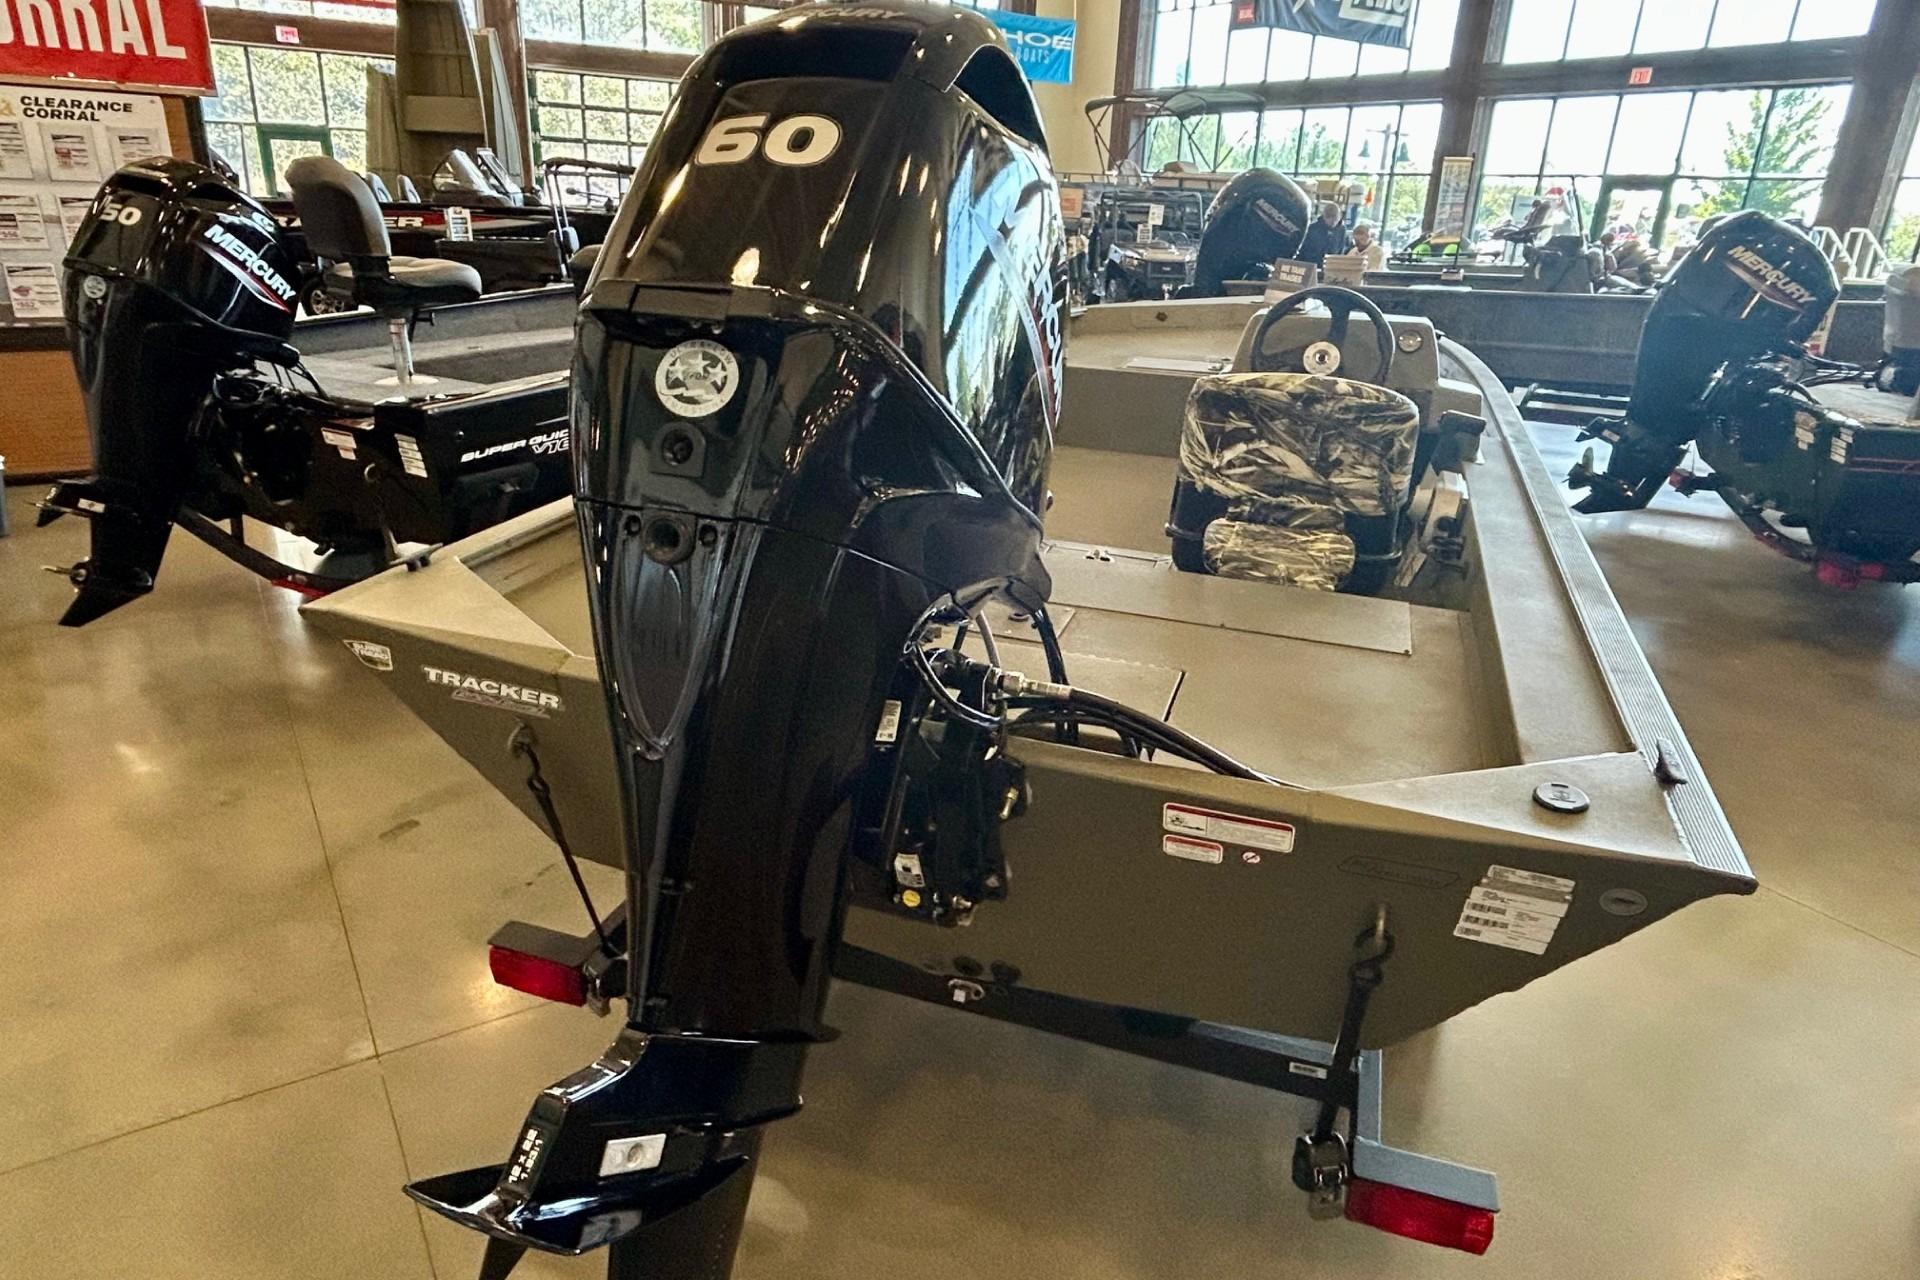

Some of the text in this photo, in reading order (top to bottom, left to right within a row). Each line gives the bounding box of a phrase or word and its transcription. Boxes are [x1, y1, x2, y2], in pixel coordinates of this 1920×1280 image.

[1001, 28, 1074, 51] HOE
[20, 95, 133, 112] CLEARANCE
[22, 107, 100, 122] CORRAL
[695, 112, 844, 167] 60
[98, 203, 142, 226] 50
[203, 223, 297, 301] MERCURY
[1727, 245, 1817, 304] MERCURY
[460, 440, 527, 462] SUPER
[423, 666, 560, 709] TRACKER
